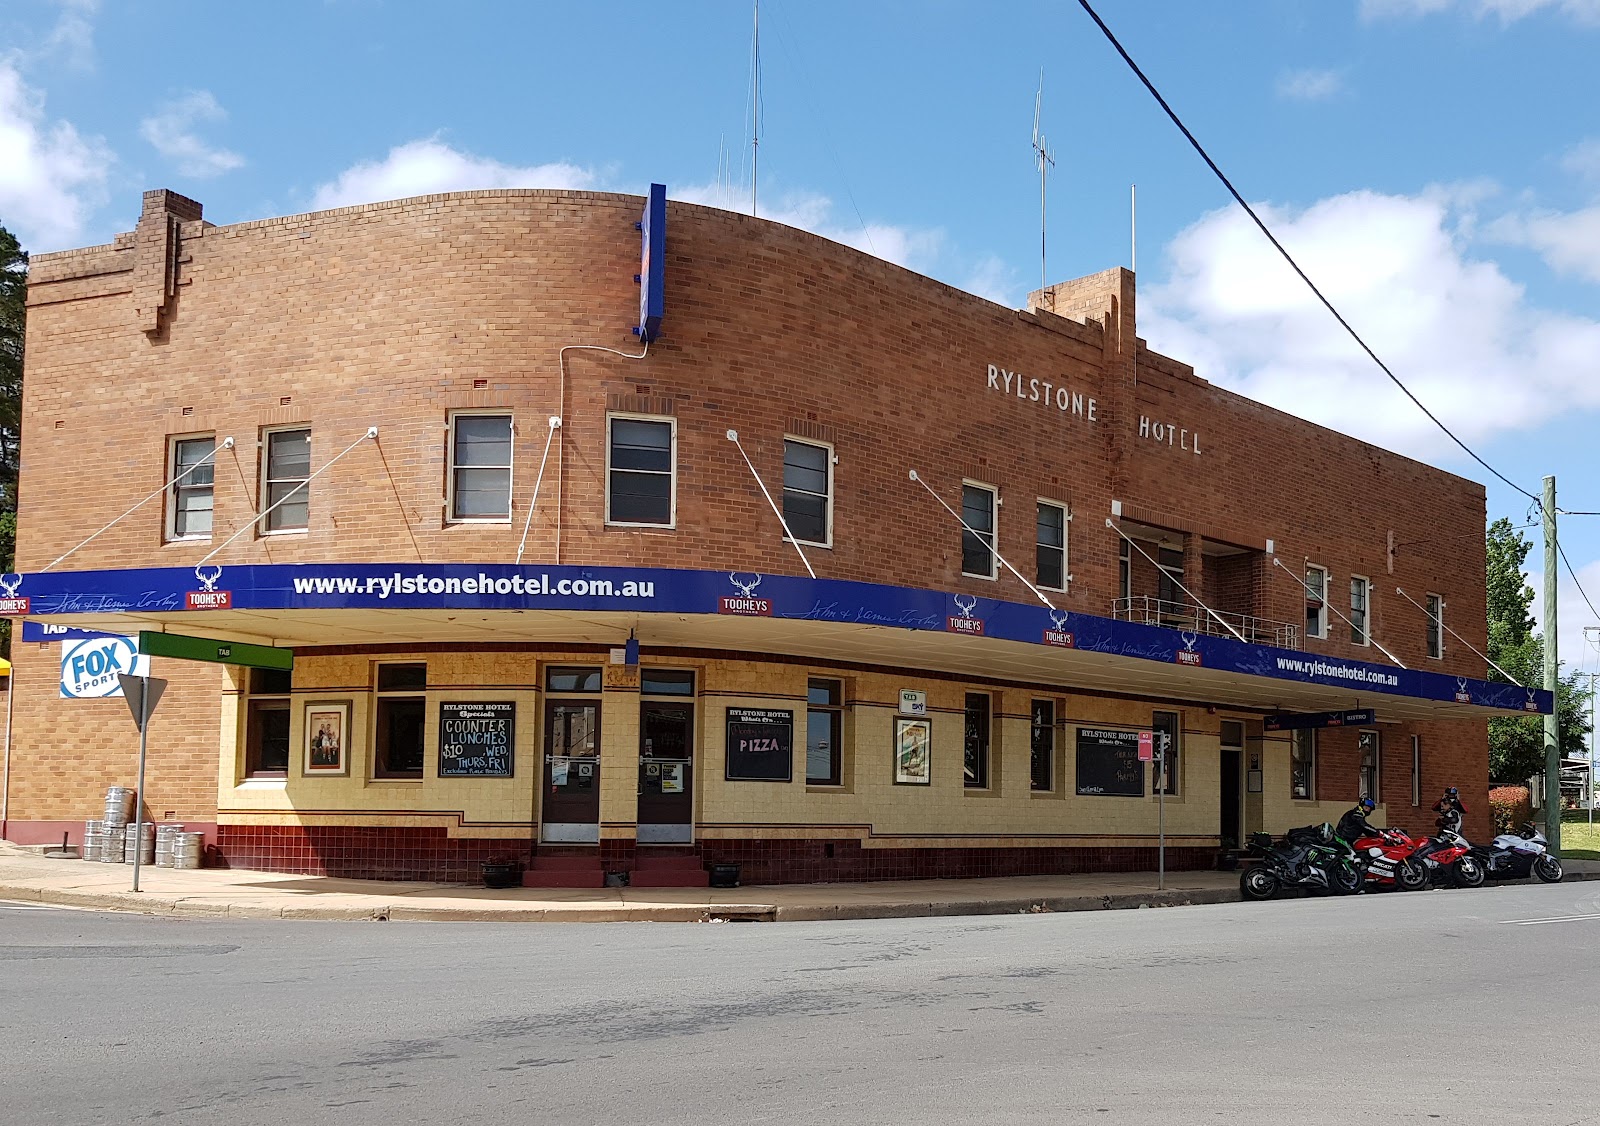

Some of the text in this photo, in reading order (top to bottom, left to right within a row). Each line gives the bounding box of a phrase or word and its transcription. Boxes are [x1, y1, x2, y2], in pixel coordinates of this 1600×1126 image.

[987, 364, 1202, 455] RYLSTONE HOTEL
[293, 572, 655, 598] www.rylstonehotel.com.au
[189, 593, 227, 605] TOOHEYS
[723, 598, 769, 612] TOOHEYS
[950, 617, 981, 631] TOOHEYS
[1046, 631, 1071, 645] TOOHEYS
[218, 648, 231, 657] TAB
[1178, 651, 1200, 663] TOOHEYS
[72, 642, 122, 685] FOX
[1277, 657, 1398, 687] www.rylstonehotel.com.au
[729, 709, 791, 719] RYLSTONE HOTEL
[446, 720, 506, 733] COUNTER
[450, 731, 507, 745] LUNCHES
[1081, 730, 1117, 740] RYLSTONE
[442, 744, 463, 759] $10
[739, 738, 780, 752] PIZZA
[488, 757, 506, 771] FRI
[1373, 861, 1392, 870] DUCATI
